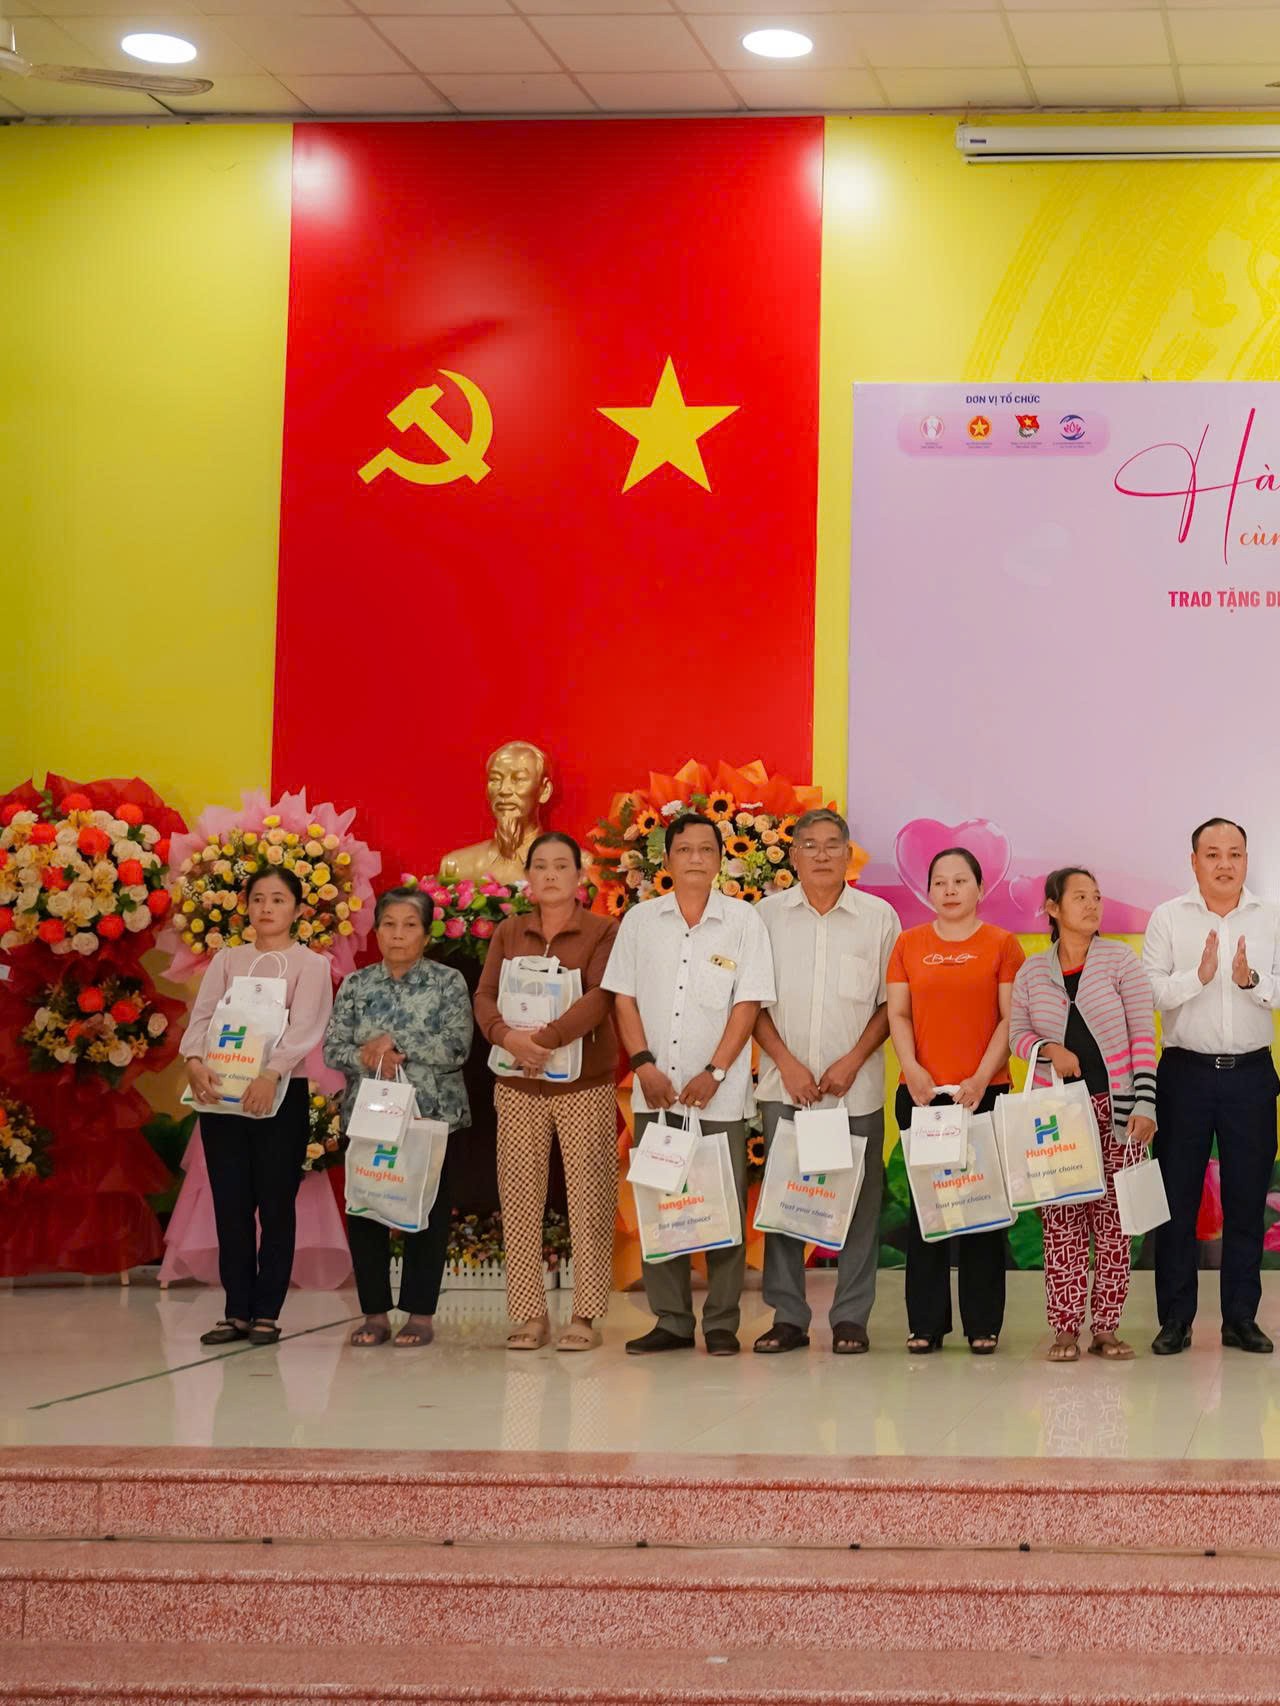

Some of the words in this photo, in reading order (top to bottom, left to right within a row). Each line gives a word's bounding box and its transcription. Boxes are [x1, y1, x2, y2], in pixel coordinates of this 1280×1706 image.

[988, 395, 998, 406] VỊ
[1014, 393, 1040, 404] CHỨC
[1168, 590, 1212, 608] TRAO
[1217, 587, 1261, 613] TẶNG
[1025, 1142, 1077, 1158] HungHau
[355, 1166, 405, 1184] HungHau
[1058, 1164, 1083, 1173] choices
[932, 1173, 985, 1190] HungHau
[786, 1181, 837, 1200] HungHau
